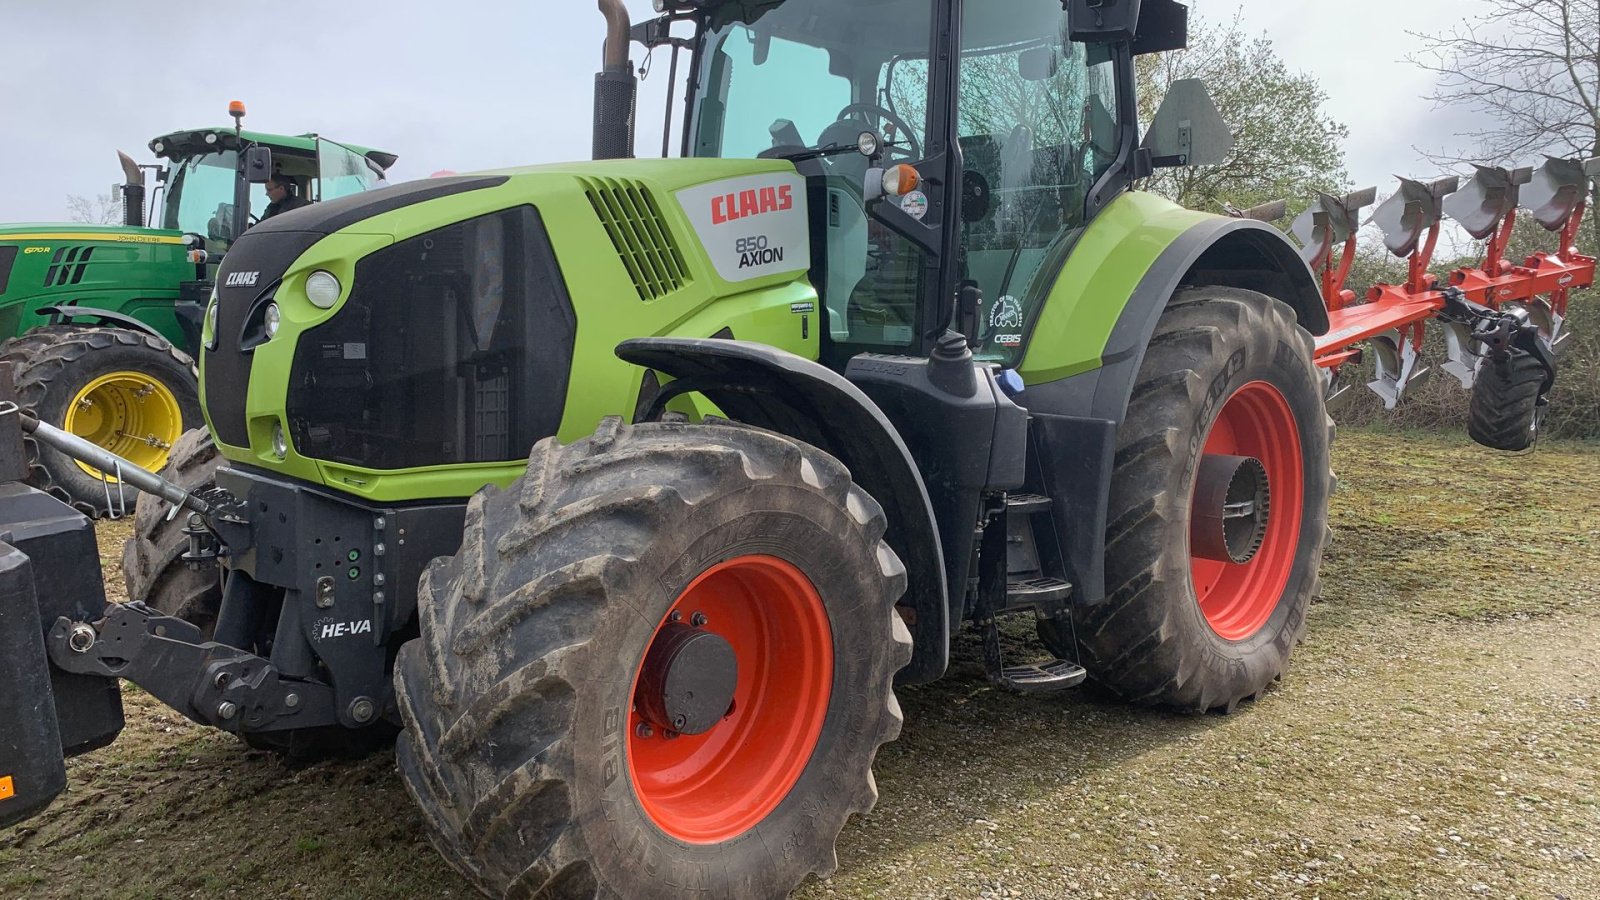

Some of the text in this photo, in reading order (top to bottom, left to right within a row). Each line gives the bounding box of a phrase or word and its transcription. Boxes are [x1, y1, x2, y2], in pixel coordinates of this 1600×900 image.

[711, 184, 792, 225] CLAAS
[735, 235, 768, 254] 850
[738, 246, 784, 269] AXION
[225, 271, 260, 286] CLAAS
[990, 300, 999, 327] TRACTOR
[994, 334, 1022, 343] CEBIS
[320, 619, 372, 639] HE-VA
